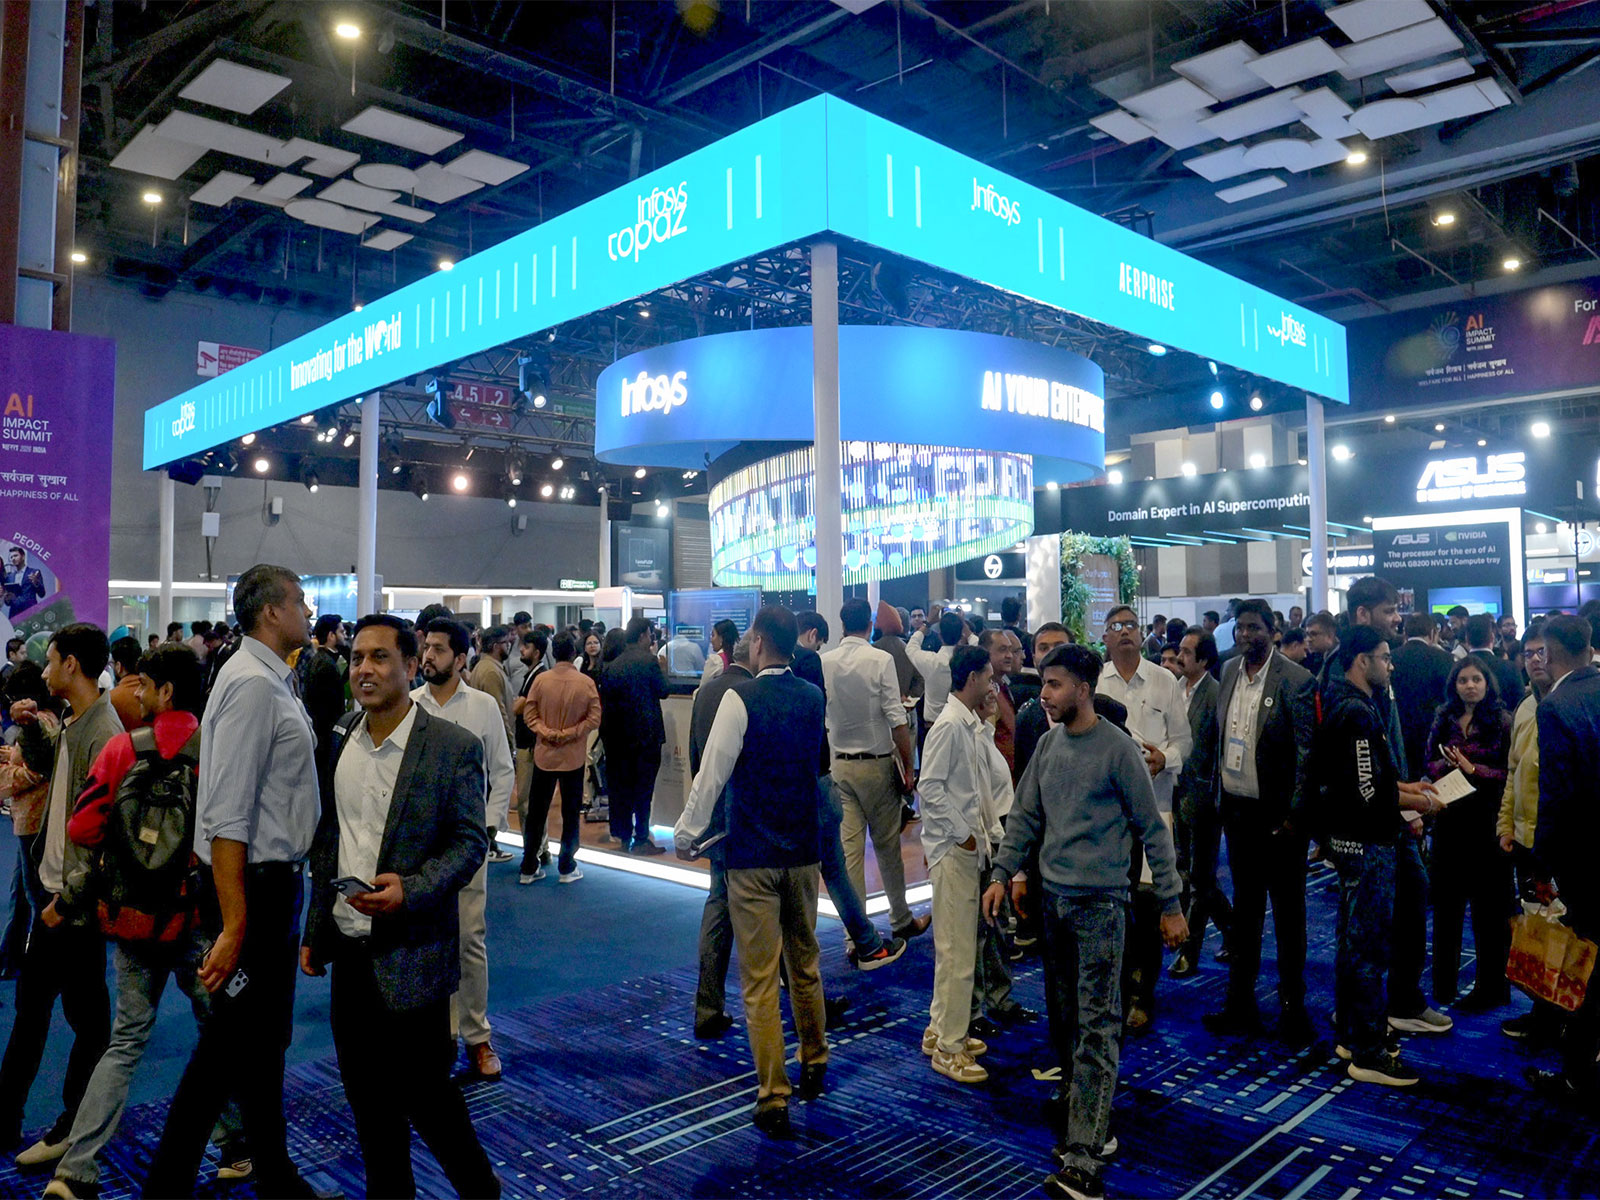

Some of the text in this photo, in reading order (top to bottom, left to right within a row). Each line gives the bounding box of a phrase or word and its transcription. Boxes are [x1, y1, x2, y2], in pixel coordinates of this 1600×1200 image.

[637, 181, 688, 223] Infosys
[971, 177, 1021, 226] Infosys
[1119, 262, 1175, 311] AERPRISE
[1574, 299, 1598, 313] For
[1466, 314, 1483, 331] AI
[1465, 327, 1493, 338] IMPACT
[1466, 334, 1496, 345] SUMMIT
[291, 348, 332, 391] Innovating
[333, 339, 346, 373] for
[347, 332, 363, 368] the
[621, 371, 687, 417] Infosys
[981, 370, 1002, 411] AI
[4, 393, 33, 417] AI
[3, 417, 49, 430] IMPACT
[2, 428, 53, 442] SUMMIT
[1416, 452, 1525, 489] ASUS
[37, 474, 67, 487] सुखाय
[0, 489, 79, 501] HAPPINESS OF ALL
[1108, 493, 1311, 522] Domain Expert in AI Supercomputin
[13, 532, 51, 561] PEOPLE
[1392, 533, 1430, 545] ASUS
[1388, 550, 1401, 559] The
[1402, 550, 1437, 559] processor
[1438, 548, 1449, 556] for
[1450, 547, 1463, 555] the
[1478, 546, 1486, 554] of
[1487, 545, 1496, 553] AI
[1383, 556, 1501, 569] NVIDIA GB200 NVL72 Compute tray
